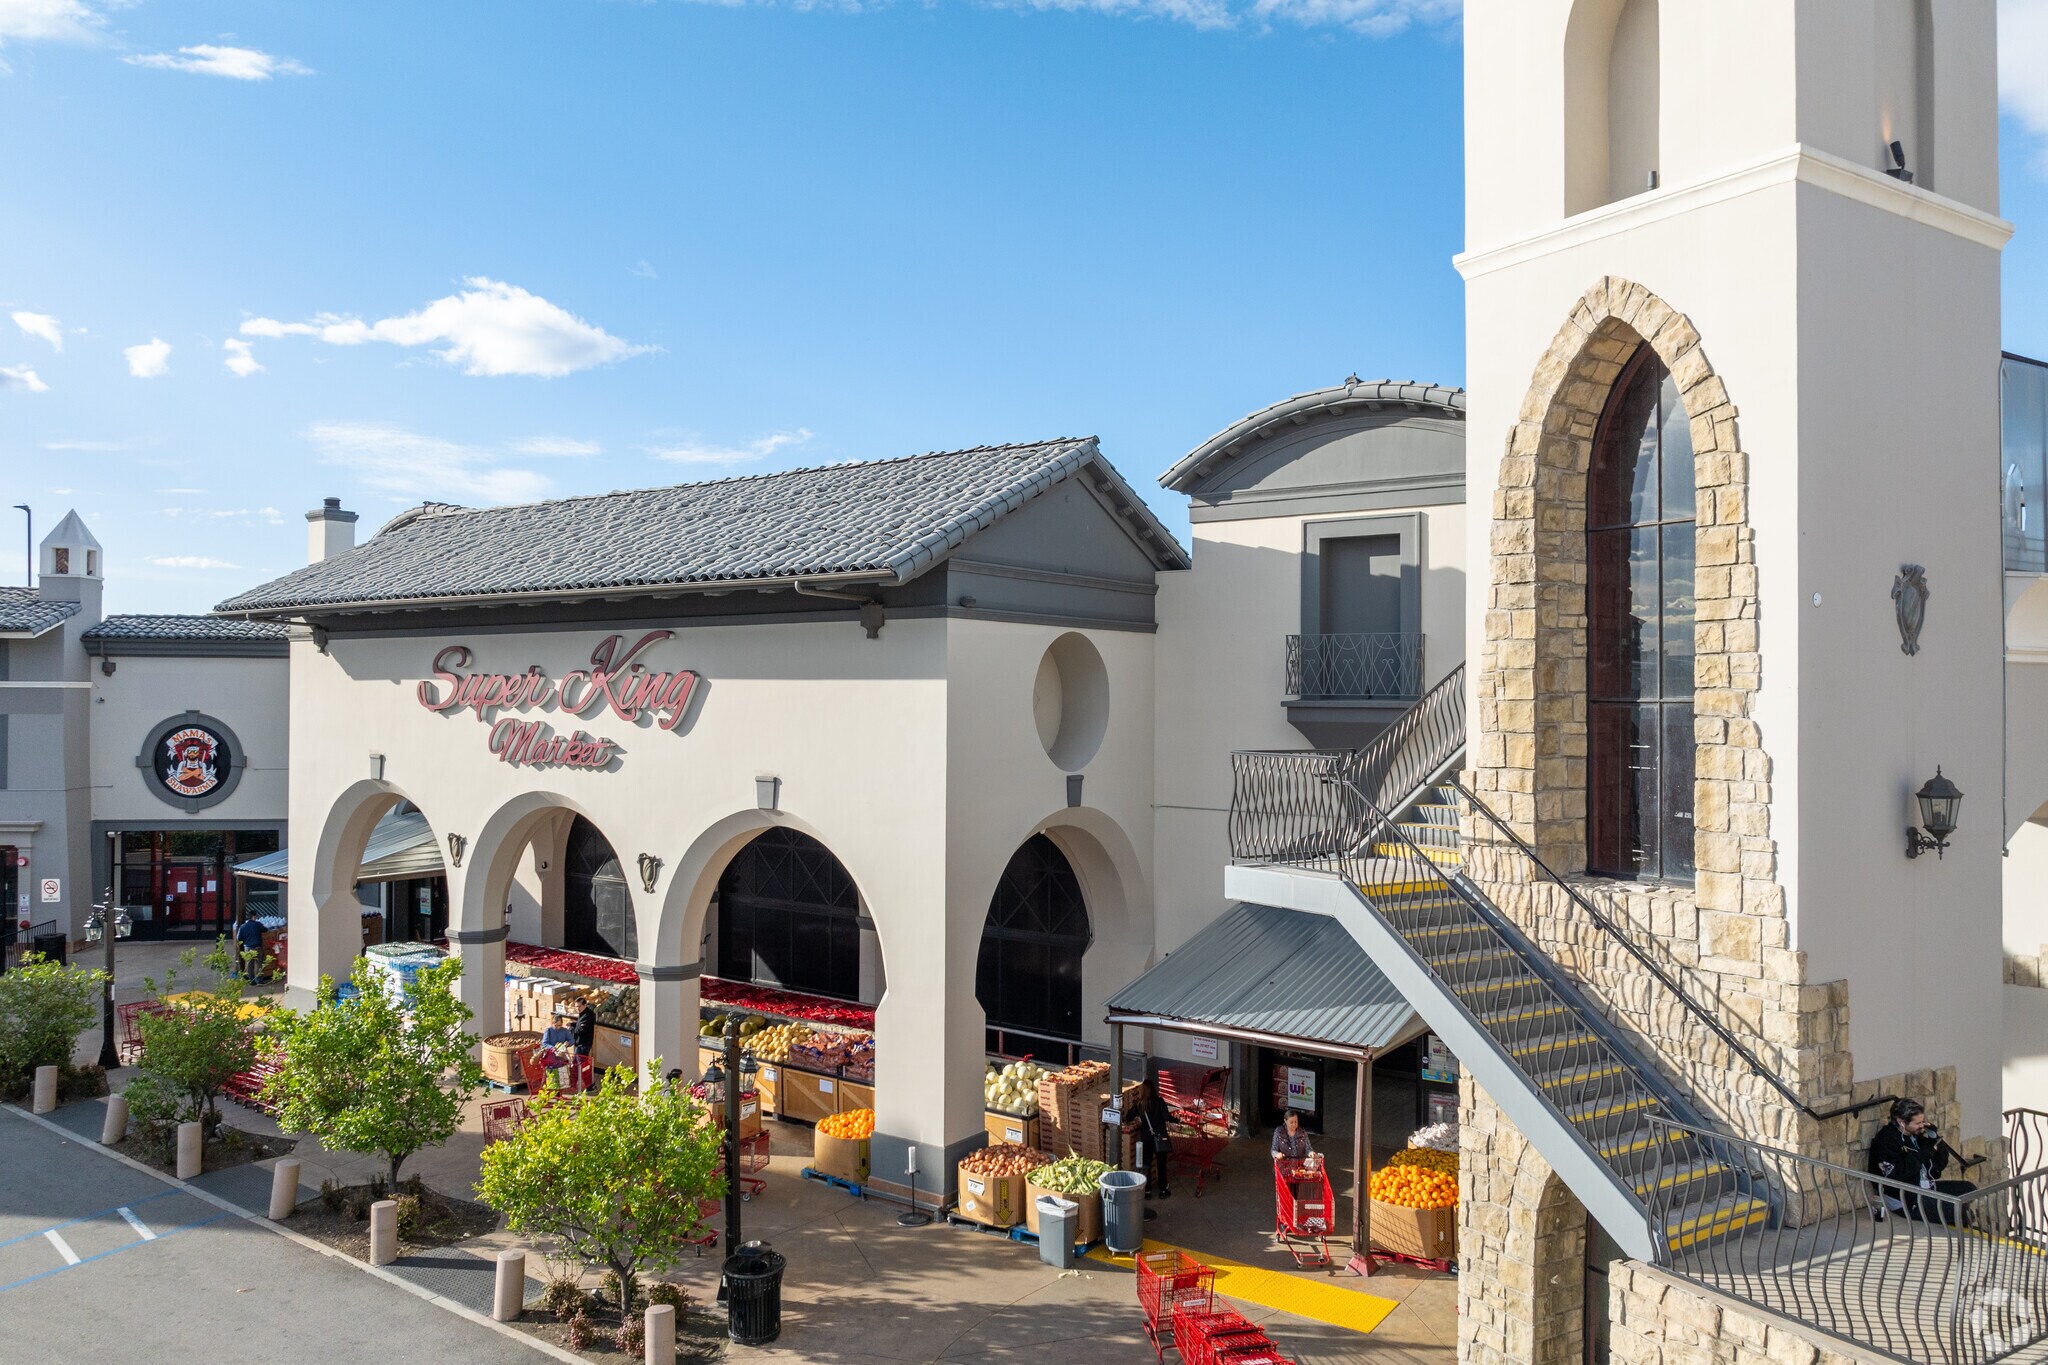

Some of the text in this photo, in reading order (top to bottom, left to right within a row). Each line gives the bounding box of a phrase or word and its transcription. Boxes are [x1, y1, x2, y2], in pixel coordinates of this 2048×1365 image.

[417, 629, 700, 730] Super King
[488, 718, 615, 767] Market
[167, 778, 216, 794] SHAWARMA
